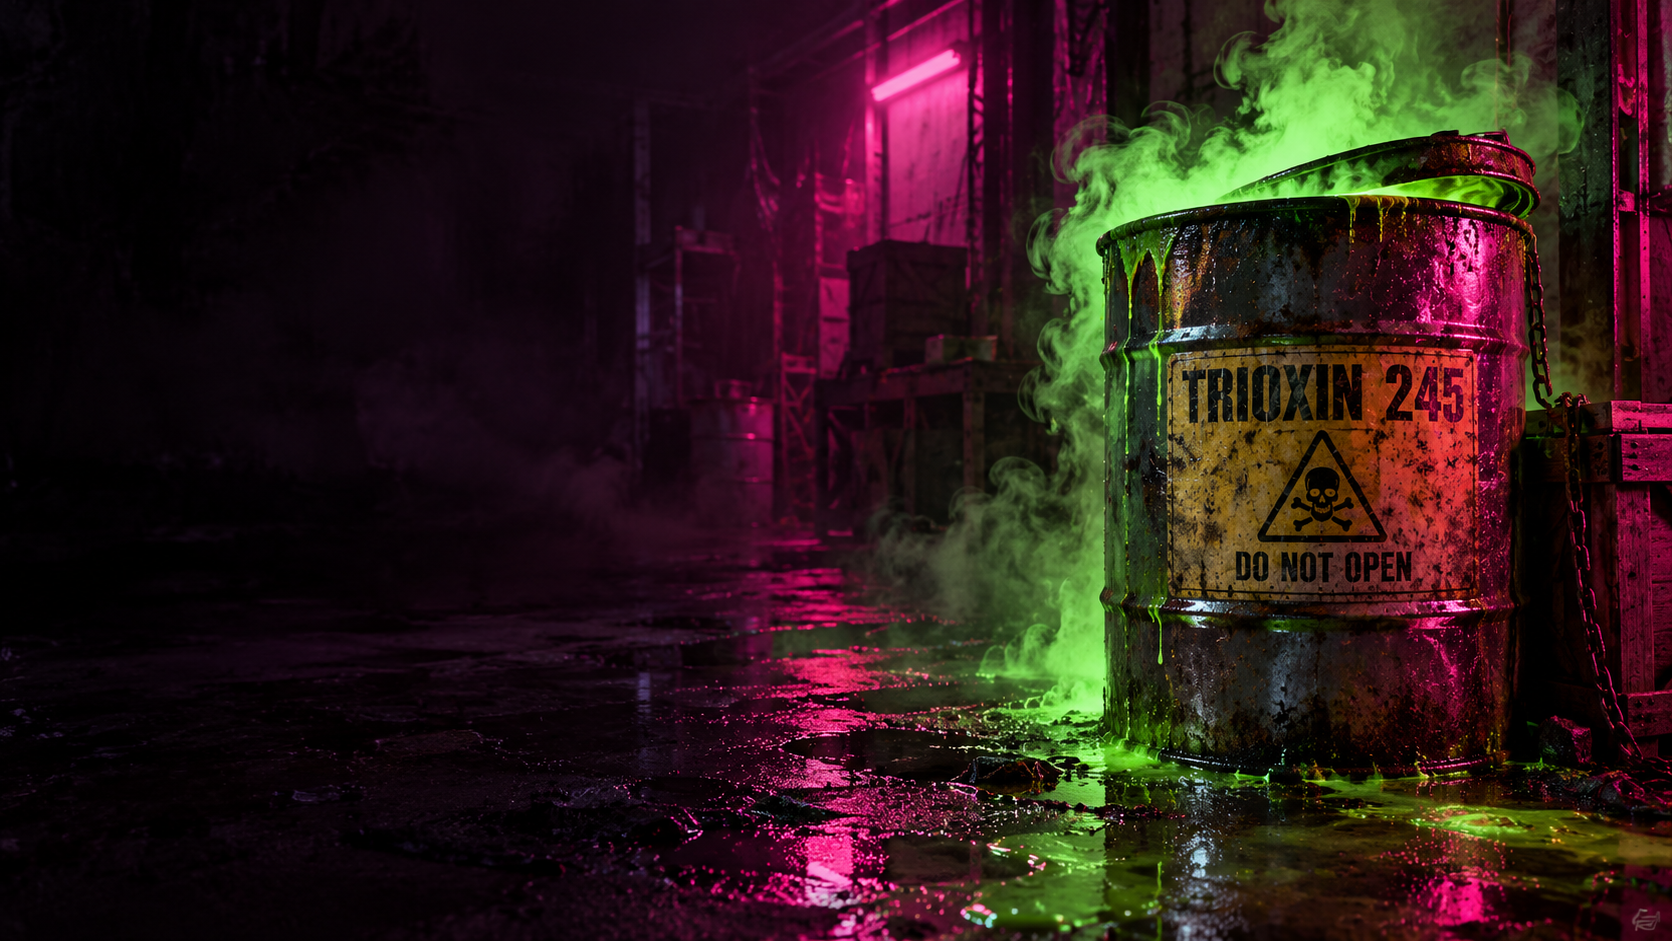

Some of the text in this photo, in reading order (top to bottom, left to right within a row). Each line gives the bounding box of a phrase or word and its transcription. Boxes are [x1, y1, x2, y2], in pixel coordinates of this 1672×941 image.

[1182, 364, 1464, 423] TRIOXIN 245
[1235, 551, 1412, 583] DO NOT OPEN
